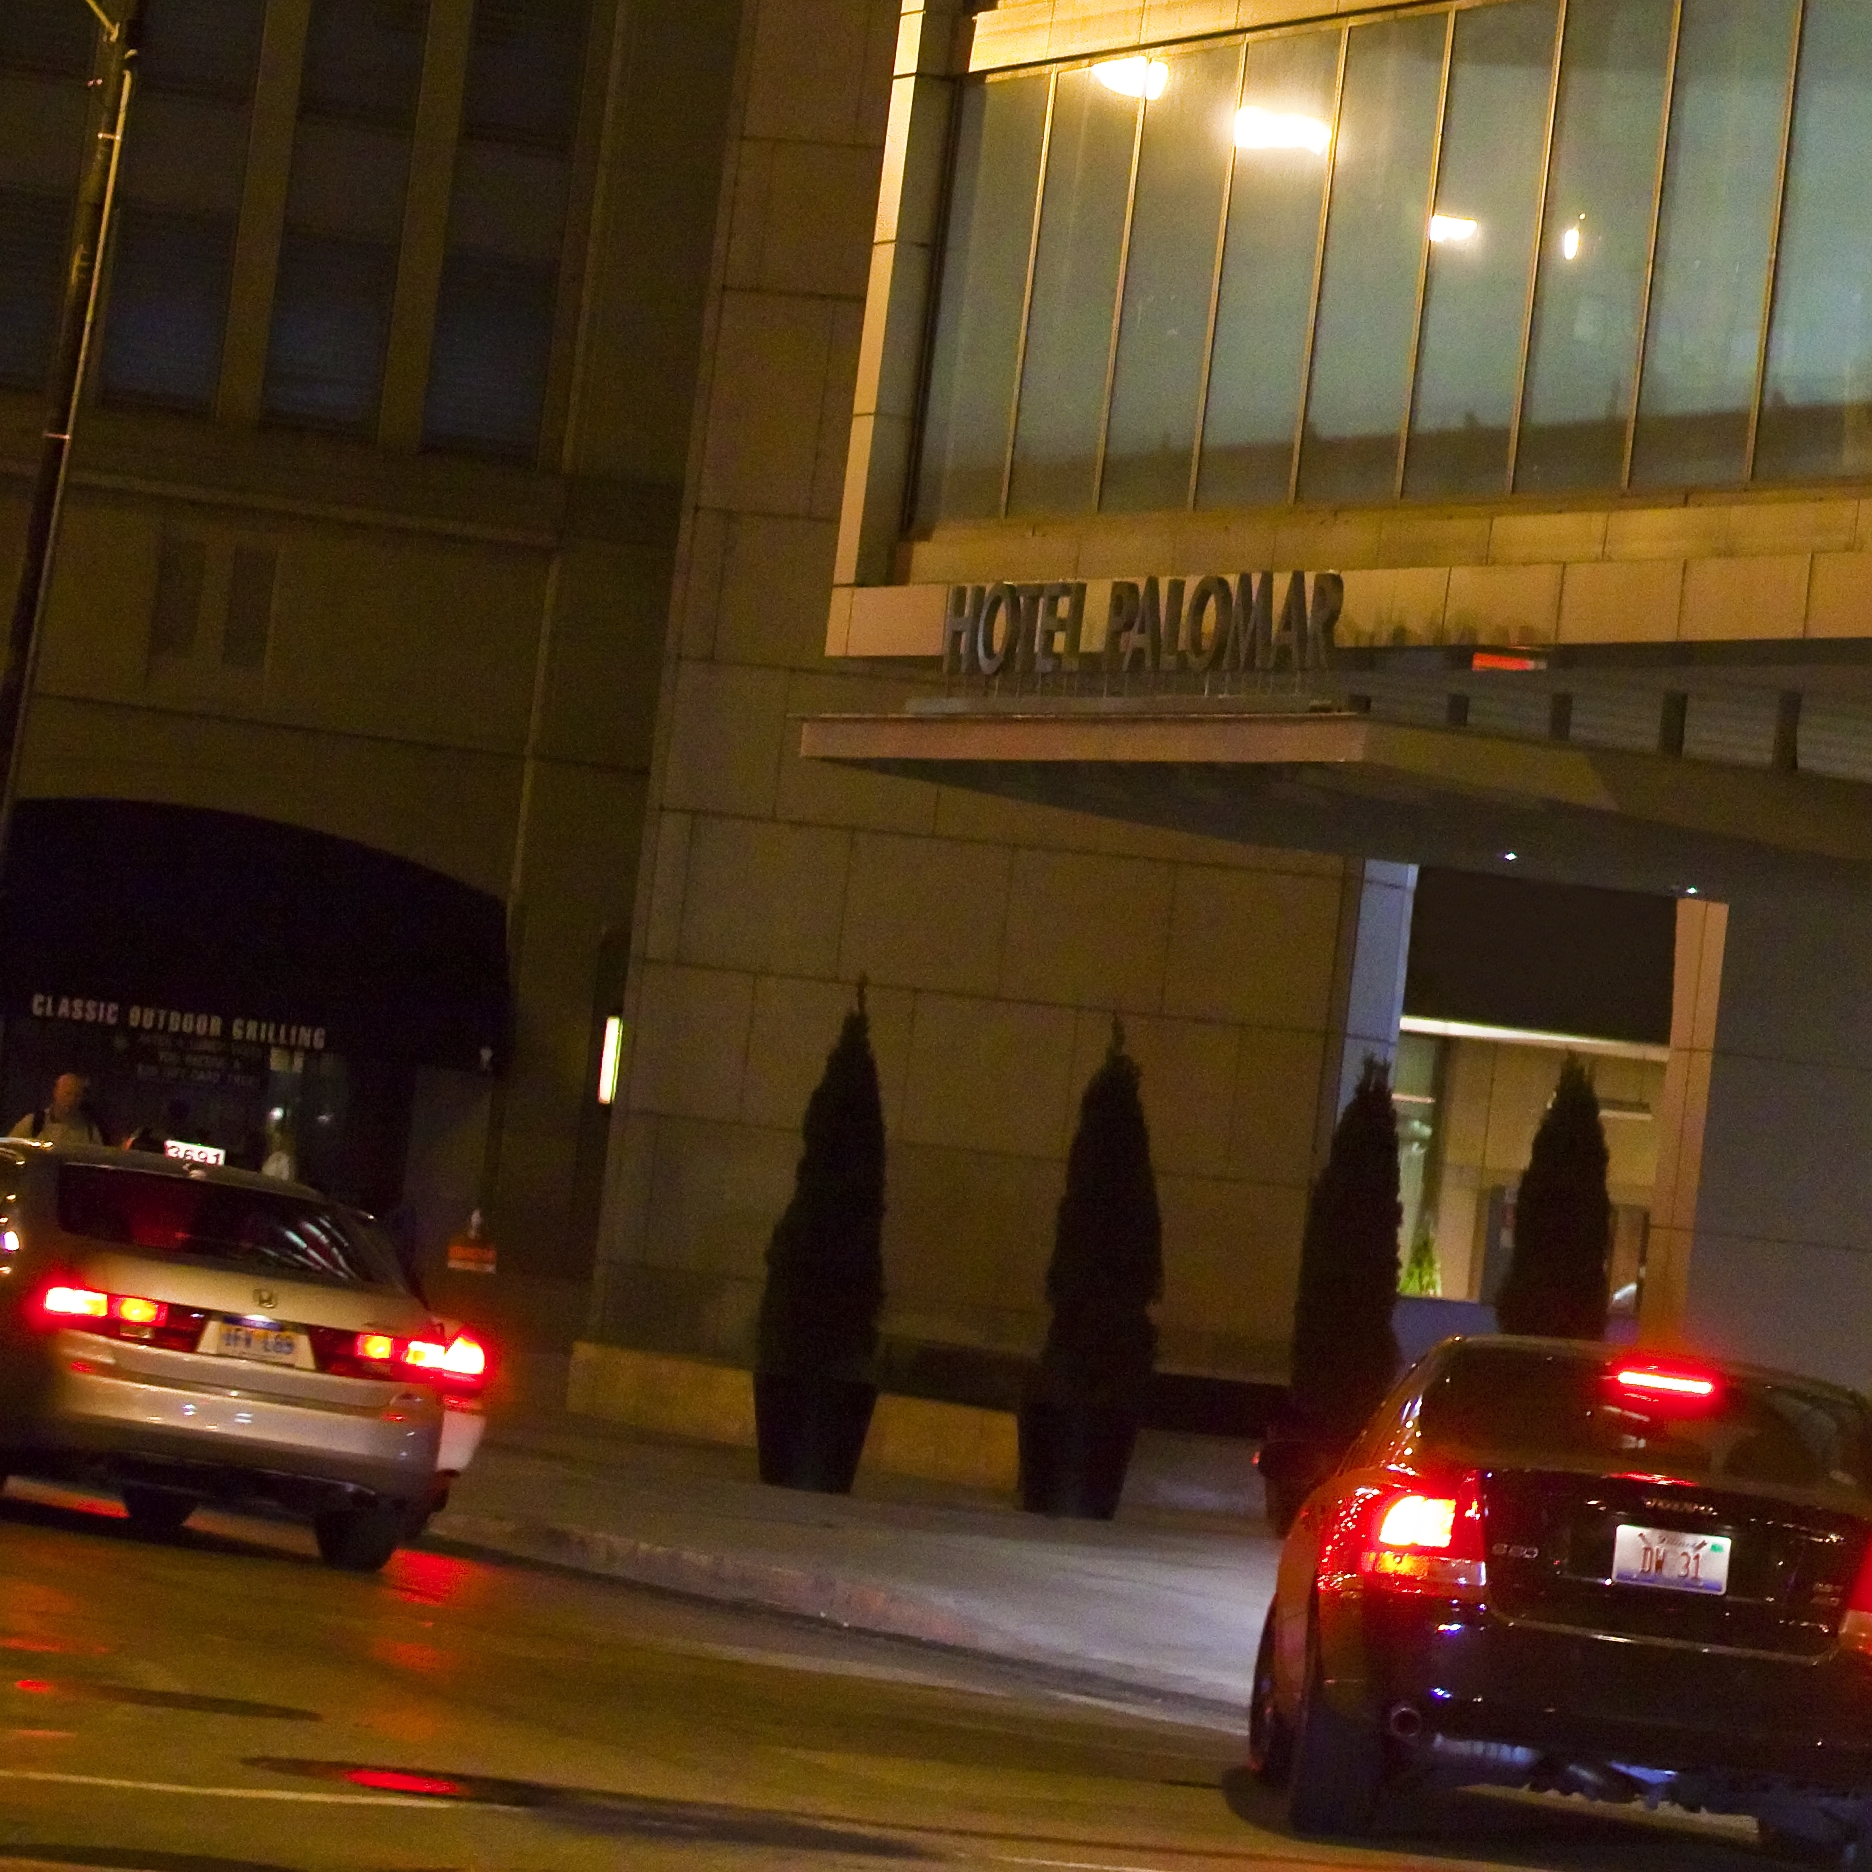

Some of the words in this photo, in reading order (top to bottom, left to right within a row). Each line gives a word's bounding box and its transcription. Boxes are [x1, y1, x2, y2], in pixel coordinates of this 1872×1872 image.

[943, 581, 1088, 674] HOTEL
[1105, 569, 1345, 674] PALOMAR
[32, 993, 119, 1025] CLASSIC
[129, 1005, 222, 1036] OUTDOOR
[232, 1018, 326, 1050] GRILLING
[1678, 1551, 1701, 1581] 31
